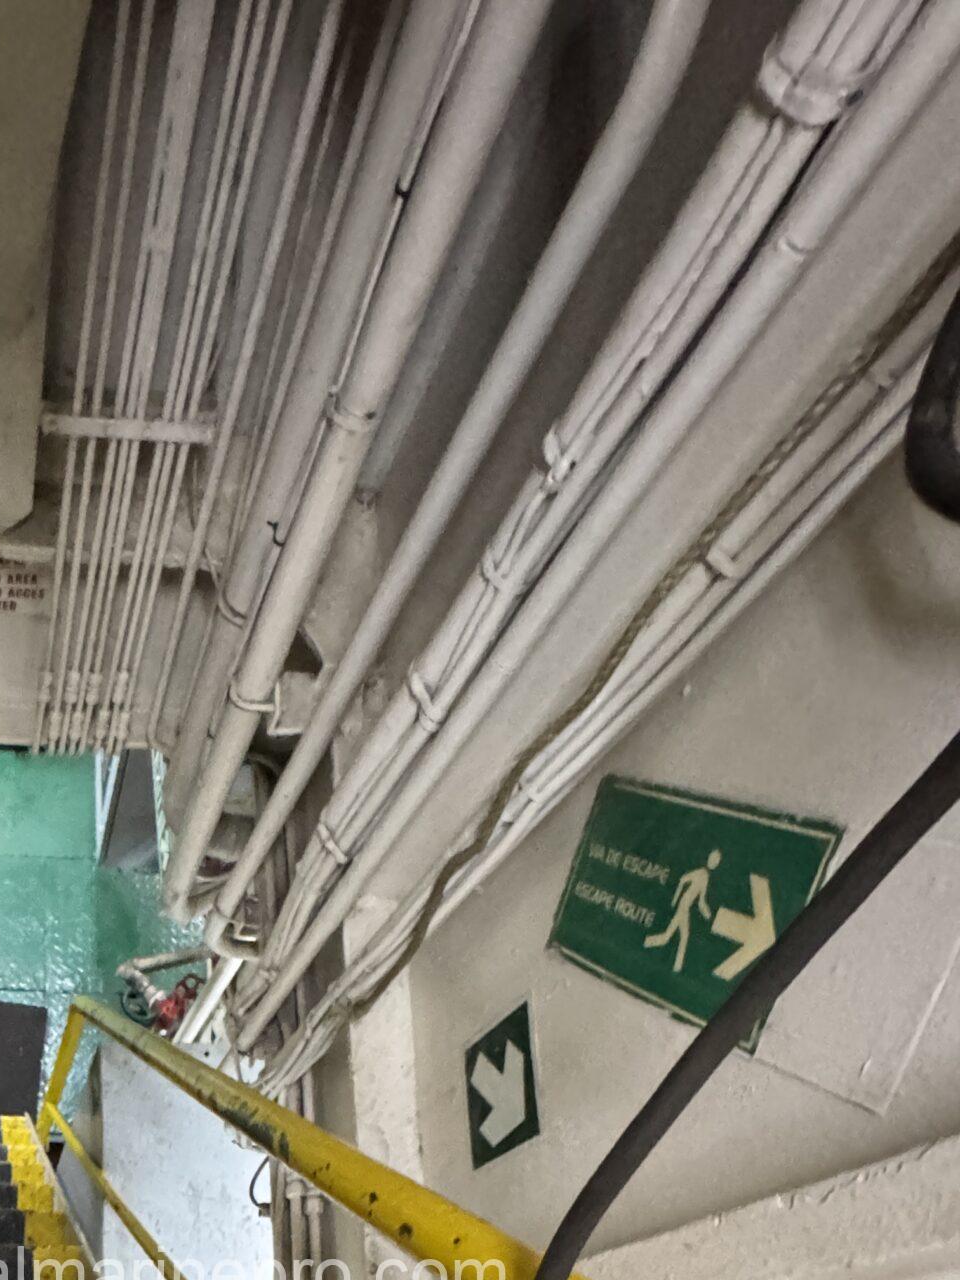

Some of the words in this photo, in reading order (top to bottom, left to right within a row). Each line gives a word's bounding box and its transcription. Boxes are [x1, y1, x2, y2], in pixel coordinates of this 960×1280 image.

[7, 573, 37, 584] AREA
[606, 848, 623, 869] DE
[623, 854, 671, 886] ESCAPE
[575, 880, 616, 911] ESCAPE
[614, 897, 656, 928] ROUTE
